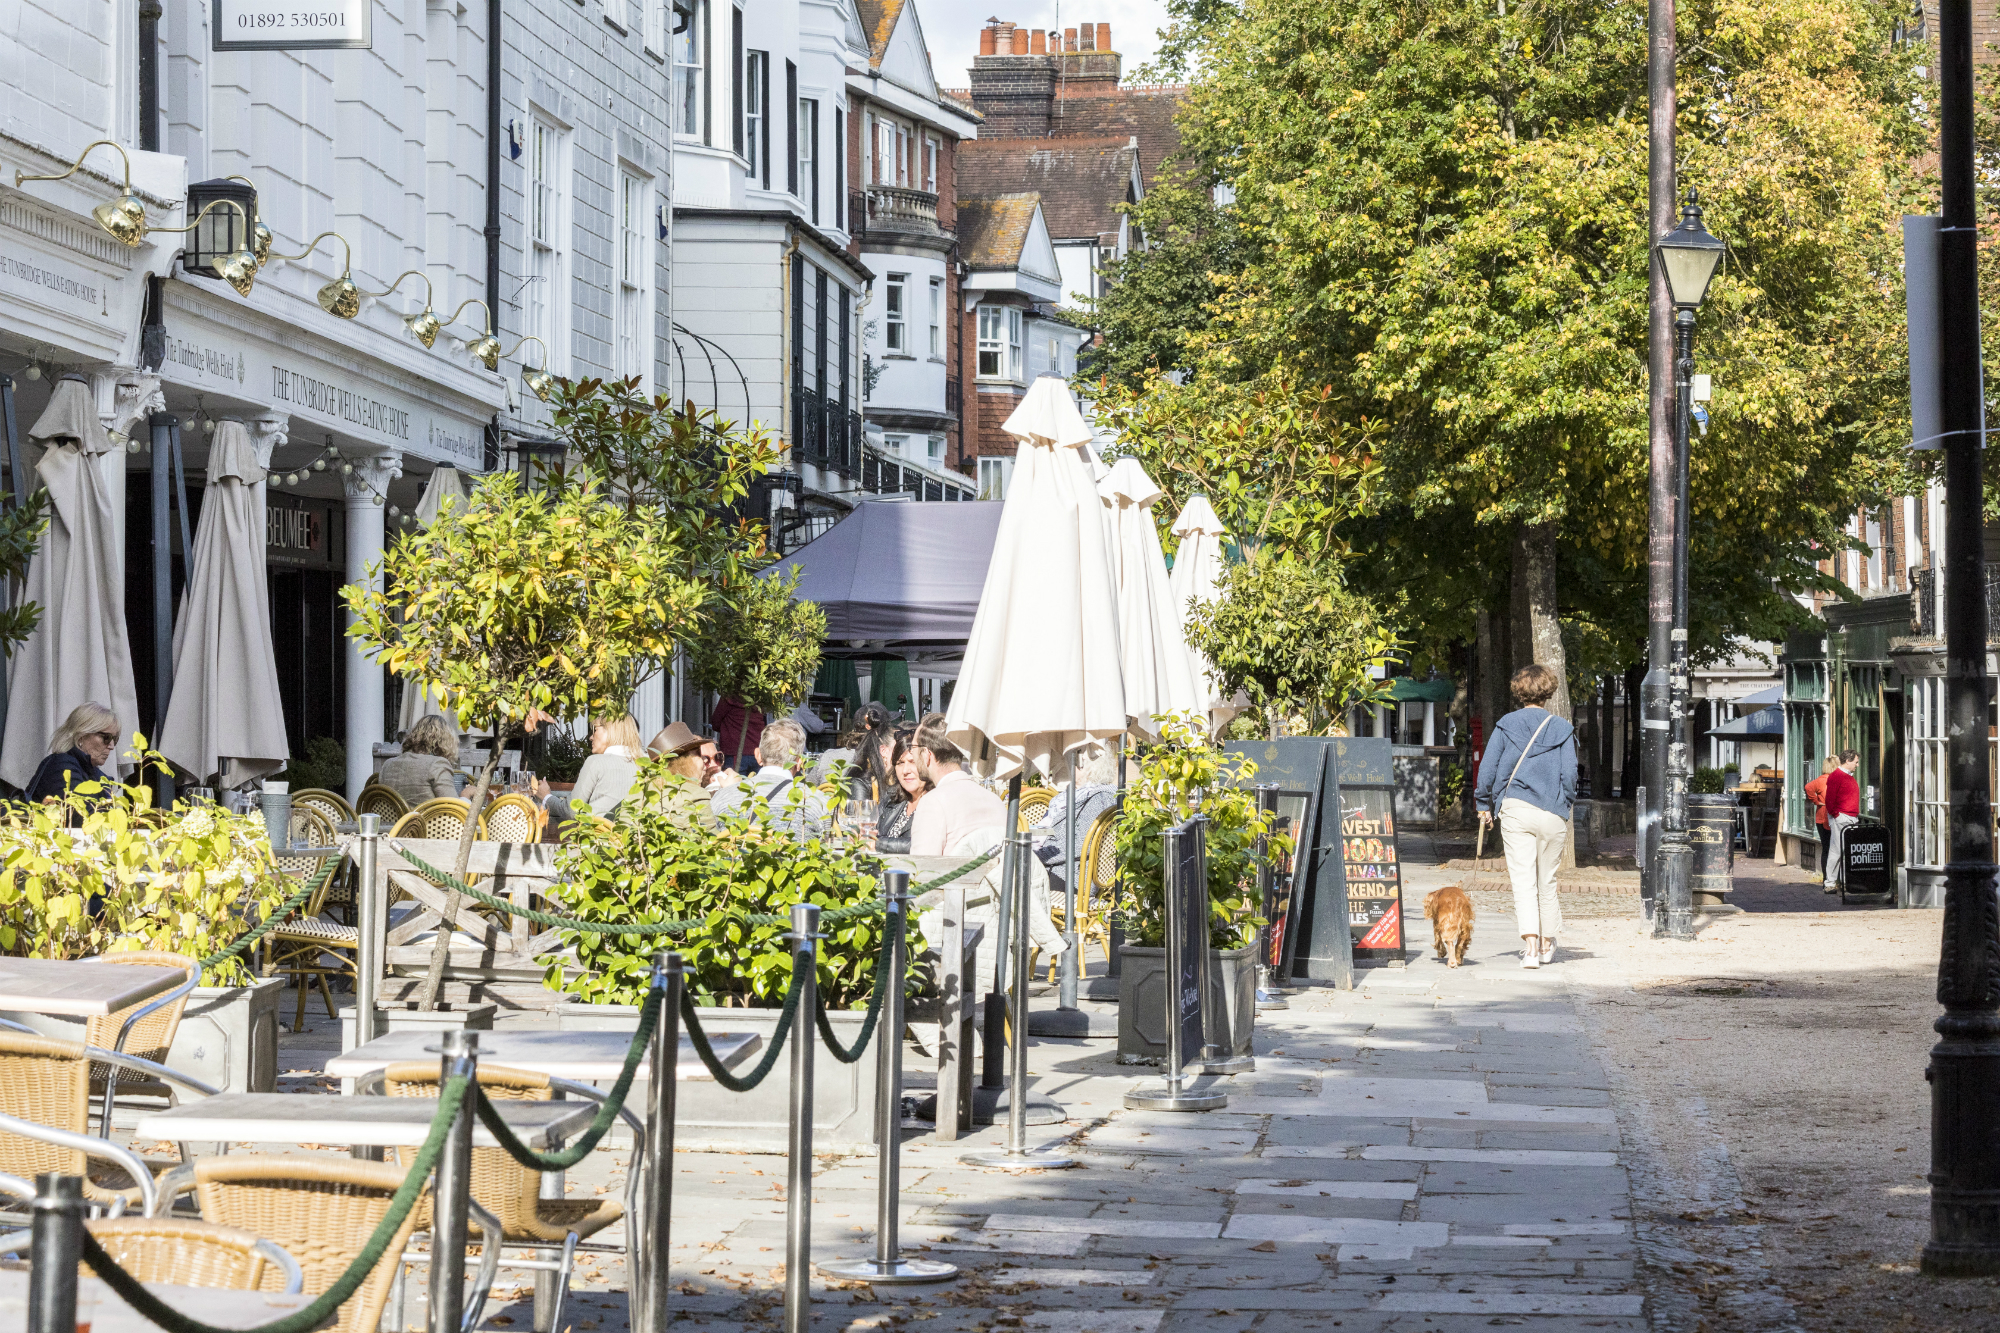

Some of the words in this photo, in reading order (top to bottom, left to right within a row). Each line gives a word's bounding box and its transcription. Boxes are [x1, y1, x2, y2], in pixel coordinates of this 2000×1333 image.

[238, 13, 285, 28] 01892
[290, 12, 346, 27] 530501
[8, 258, 41, 284] TUNBRIDGE
[41, 269, 60, 292] WELLS
[60, 276, 80, 298] EATING
[80, 284, 97, 305] HOUSE
[165, 335, 176, 362] The
[178, 339, 204, 377] Tunbridge
[205, 348, 219, 376] Wells
[220, 353, 234, 380] Hotel
[272, 365, 289, 401] THE
[291, 372, 336, 416] TUNBRIDGE
[337, 388, 361, 424] WELLS
[362, 397, 388, 433] EATING
[388, 406, 409, 440] HOUSE
[1366, 773, 1385, 782] Hotel
[1850, 843, 1883, 854] poggen
[1851, 853, 1870, 865] pohl
[1366, 924, 1381, 941] Saturday
[1371, 931, 1384, 945] Sunday
